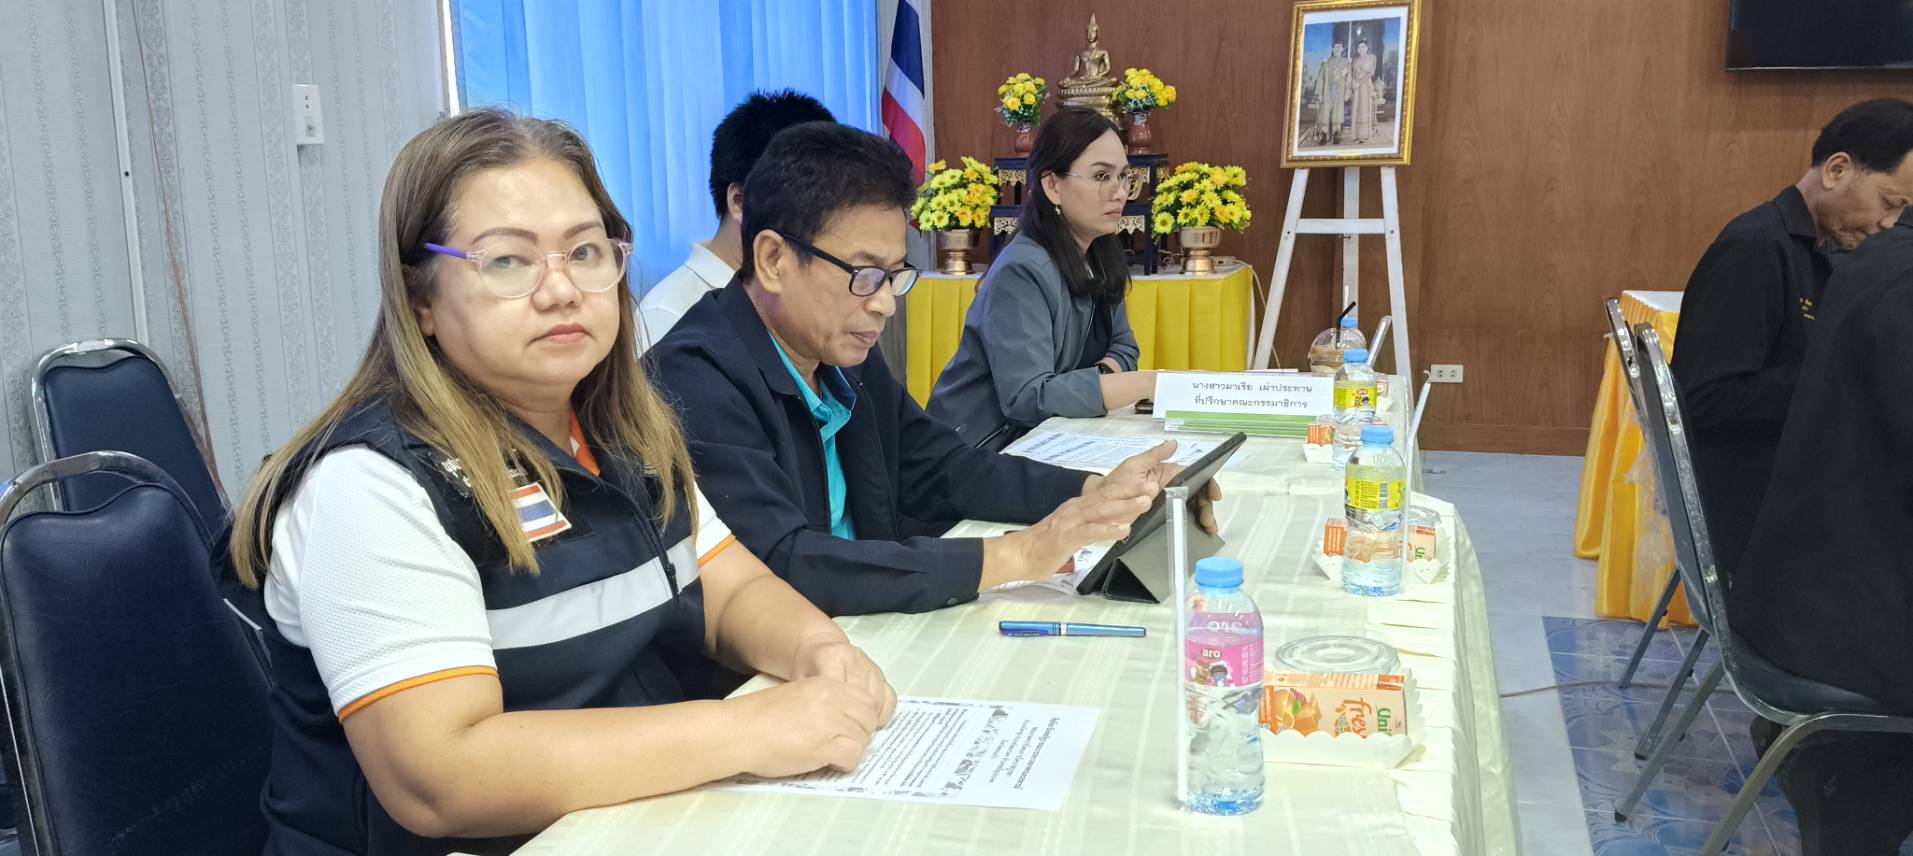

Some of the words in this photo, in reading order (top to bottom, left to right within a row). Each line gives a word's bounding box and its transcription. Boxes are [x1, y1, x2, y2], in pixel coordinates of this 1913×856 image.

[1201, 648, 1221, 658] aro
[1343, 697, 1372, 739] fres
[1377, 707, 1392, 737] Uni
